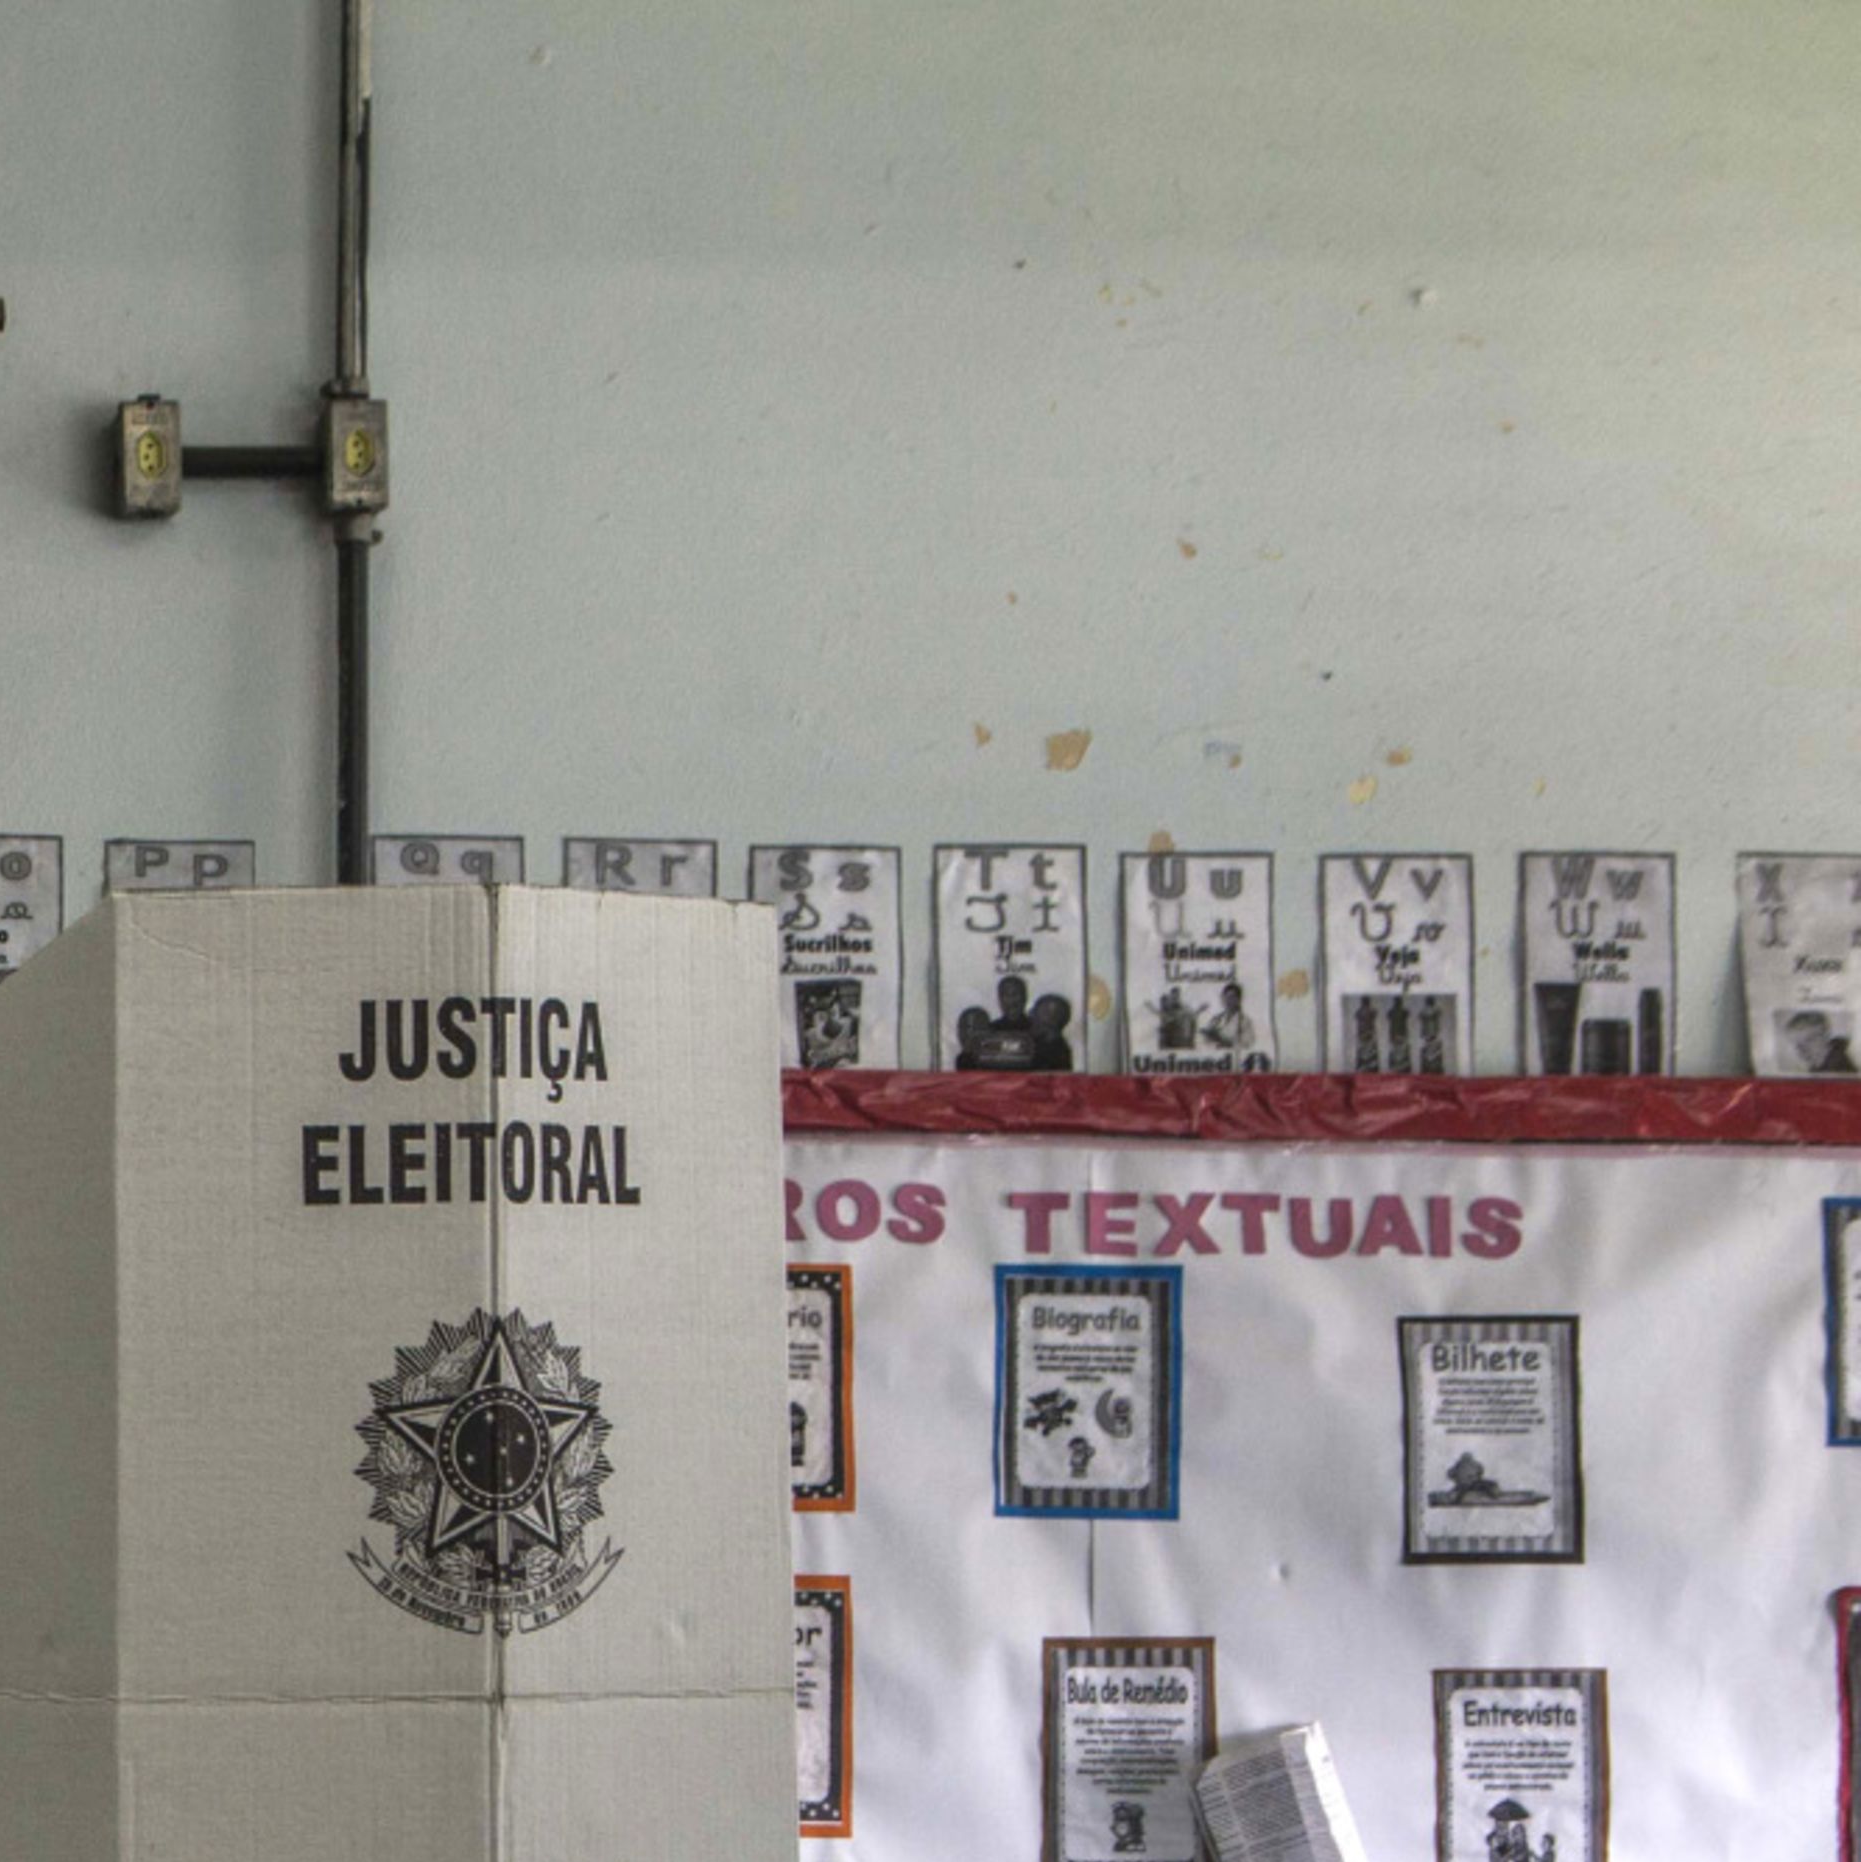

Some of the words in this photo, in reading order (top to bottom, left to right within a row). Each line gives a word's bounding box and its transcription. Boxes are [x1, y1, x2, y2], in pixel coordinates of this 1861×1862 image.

[134, 845, 169, 878] P
[192, 853, 228, 888] p
[782, 934, 872, 954] Sucrilhos
[1162, 942, 1236, 962] Unimed
[338, 996, 608, 1102] JUSTIÇA
[1134, 1053, 1232, 1075] Unimed
[302, 1120, 642, 1205] ELEITORAL
[1007, 1191, 1525, 1260] TEXTUAIS
[1029, 1304, 1140, 1335] Biografia
[1429, 1344, 1541, 1375] Bilhete
[1102, 1679, 1121, 1705] de
[1463, 1700, 1577, 1731] Entrevista
